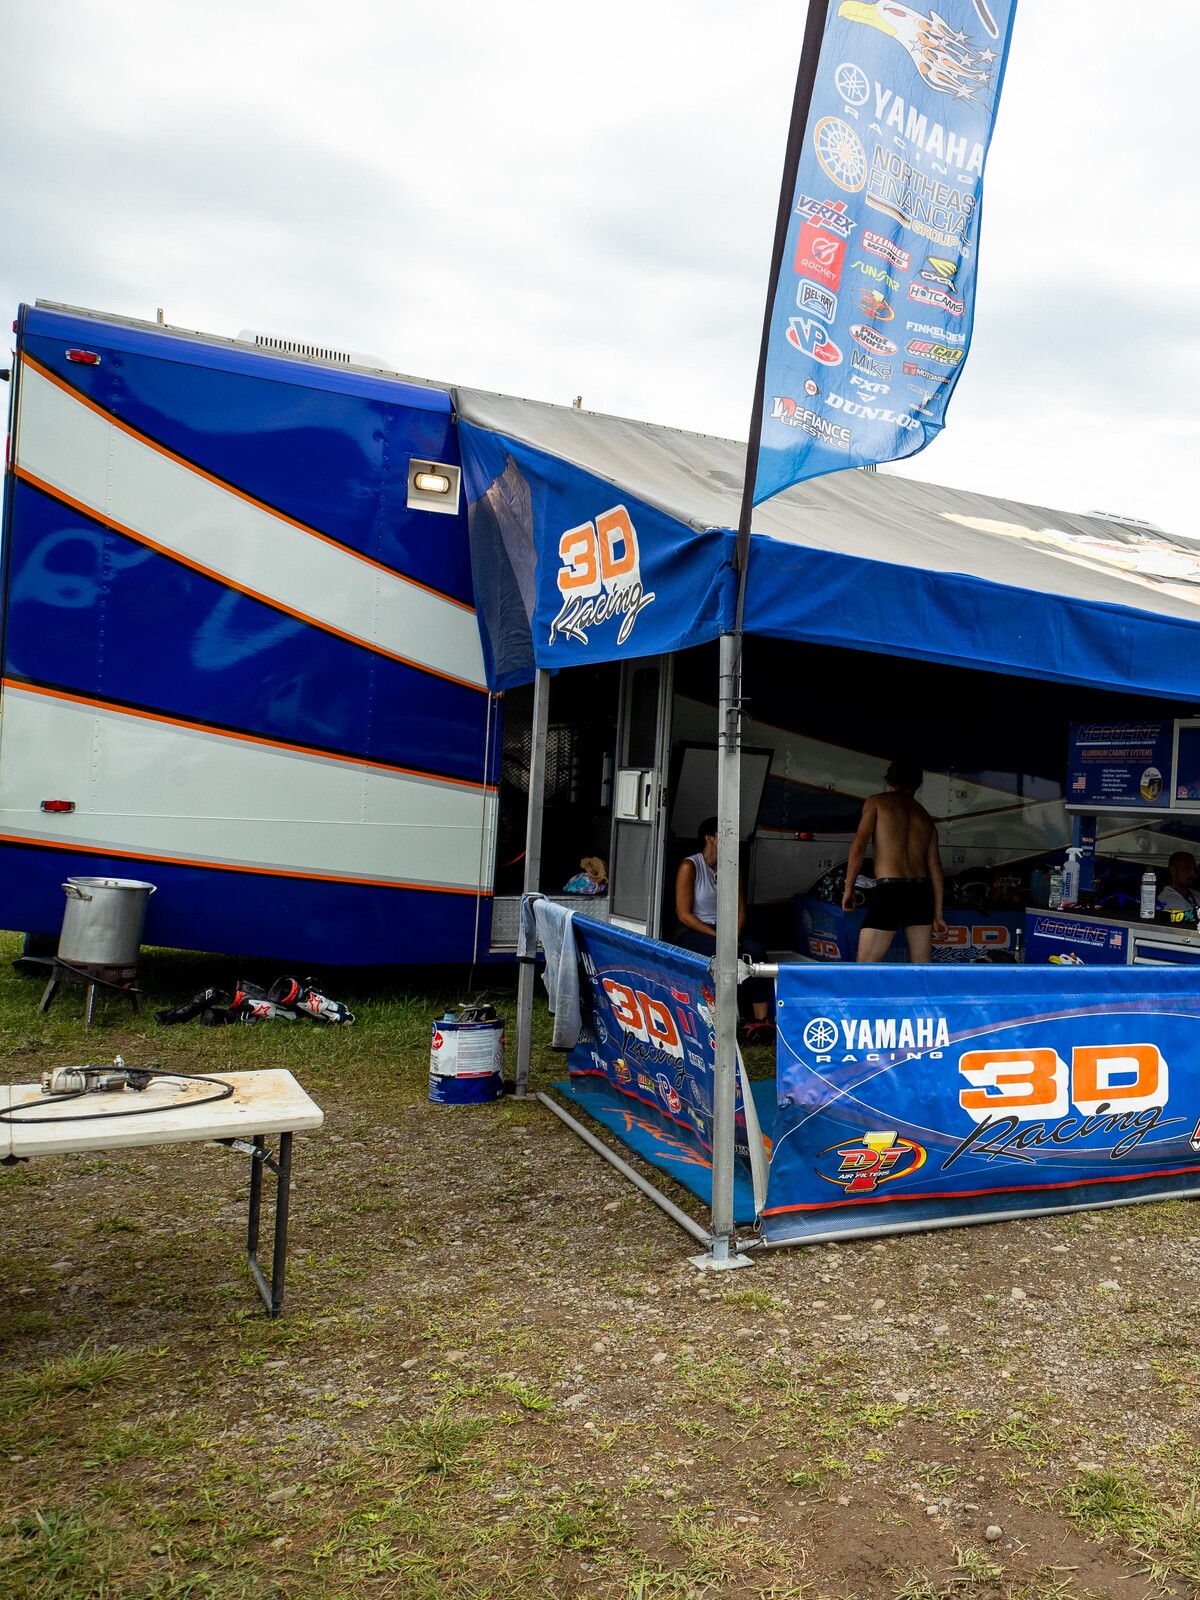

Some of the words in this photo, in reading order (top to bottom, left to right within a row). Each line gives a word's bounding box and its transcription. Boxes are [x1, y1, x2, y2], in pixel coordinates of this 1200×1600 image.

[844, 104, 974, 186] RACING
[873, 80, 985, 178] YAMAHA
[872, 145, 977, 217] NORTHEAS
[799, 195, 854, 232] VERTEX
[864, 231, 910, 260] CYLINDER
[911, 218, 959, 248] GROUP
[800, 259, 837, 281] ROCKET
[789, 318, 829, 356] VP
[849, 373, 891, 395] FXR
[824, 392, 922, 431] DUNLOP
[780, 414, 850, 449] LIFESTYLE
[558, 505, 639, 594] 3D
[549, 581, 656, 646] Racing
[1109, 749, 1129, 757] CABINET
[1130, 748, 1153, 757] SYSTEMS
[1034, 917, 1109, 944] MODULINE
[602, 978, 684, 1053] 3D
[840, 1017, 950, 1050] YAMAHA
[621, 1026, 696, 1090] Racing
[816, 1050, 944, 1063] RACING
[959, 1044, 1165, 1116] 3D
[941, 1102, 1187, 1171] Racing
[838, 1172, 854, 1180] AIR
[855, 1169, 891, 1179] FILTERS
